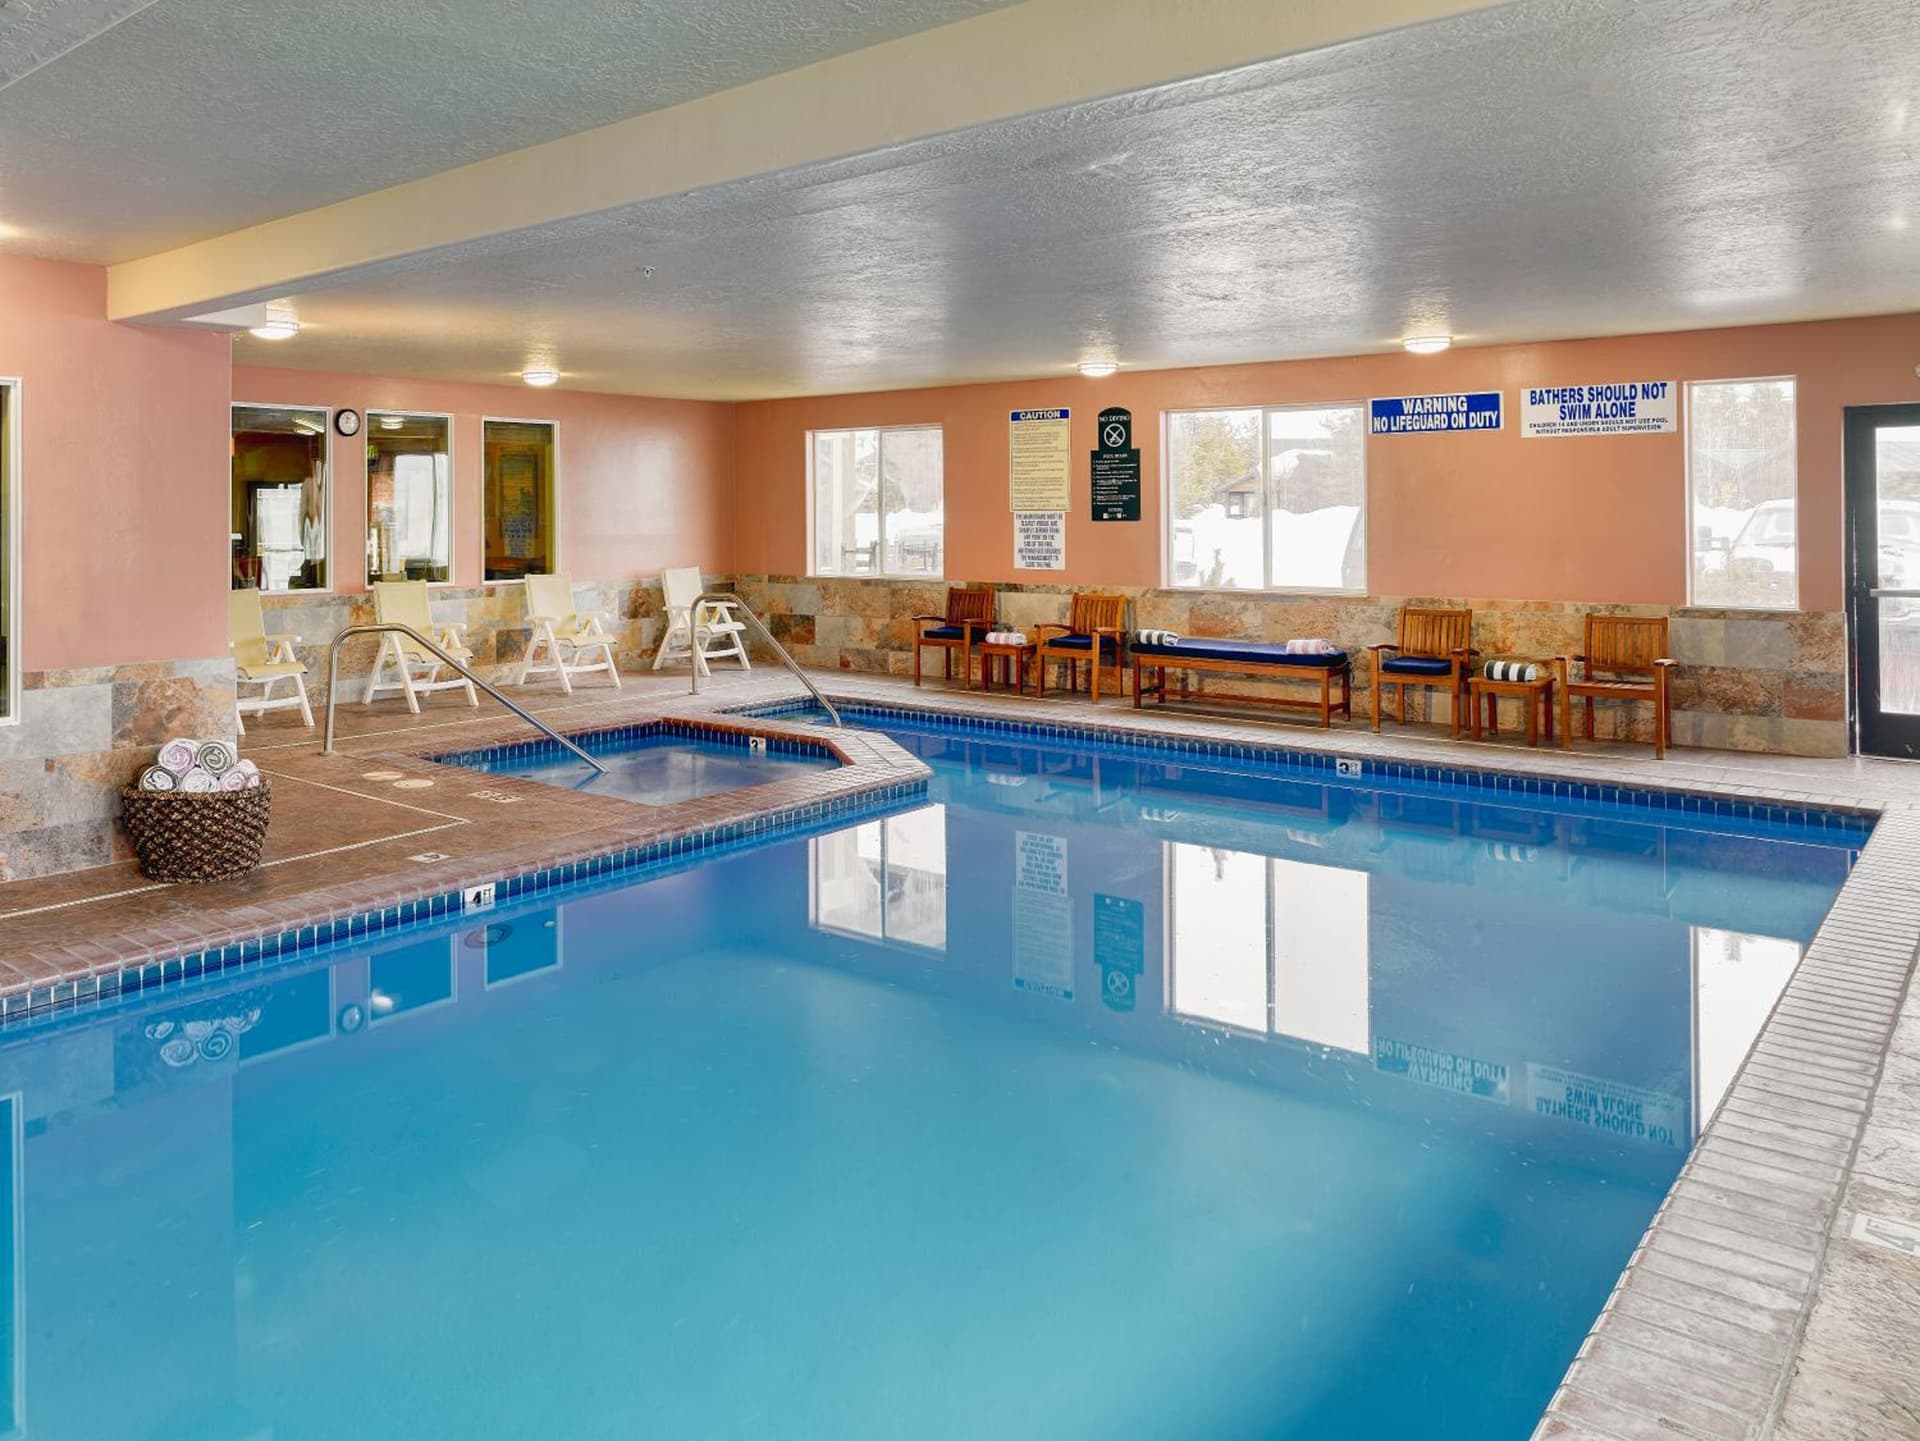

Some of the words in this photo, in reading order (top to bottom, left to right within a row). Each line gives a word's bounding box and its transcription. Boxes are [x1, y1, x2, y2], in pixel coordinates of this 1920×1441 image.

[1530, 387, 1584, 405] BATHERS
[1587, 384, 1638, 402] SHOULD
[1641, 382, 1667, 400] NOT
[1019, 410, 1061, 420] CAUTION
[1402, 396, 1468, 414] WARNING
[1560, 403, 1592, 421] SWIM
[1595, 401, 1636, 419] ALONE
[1373, 416, 1388, 432] NO
[1390, 413, 1448, 431] LIFEGUARD
[1451, 413, 1466, 428] ON
[1469, 410, 1498, 428] DUTY
